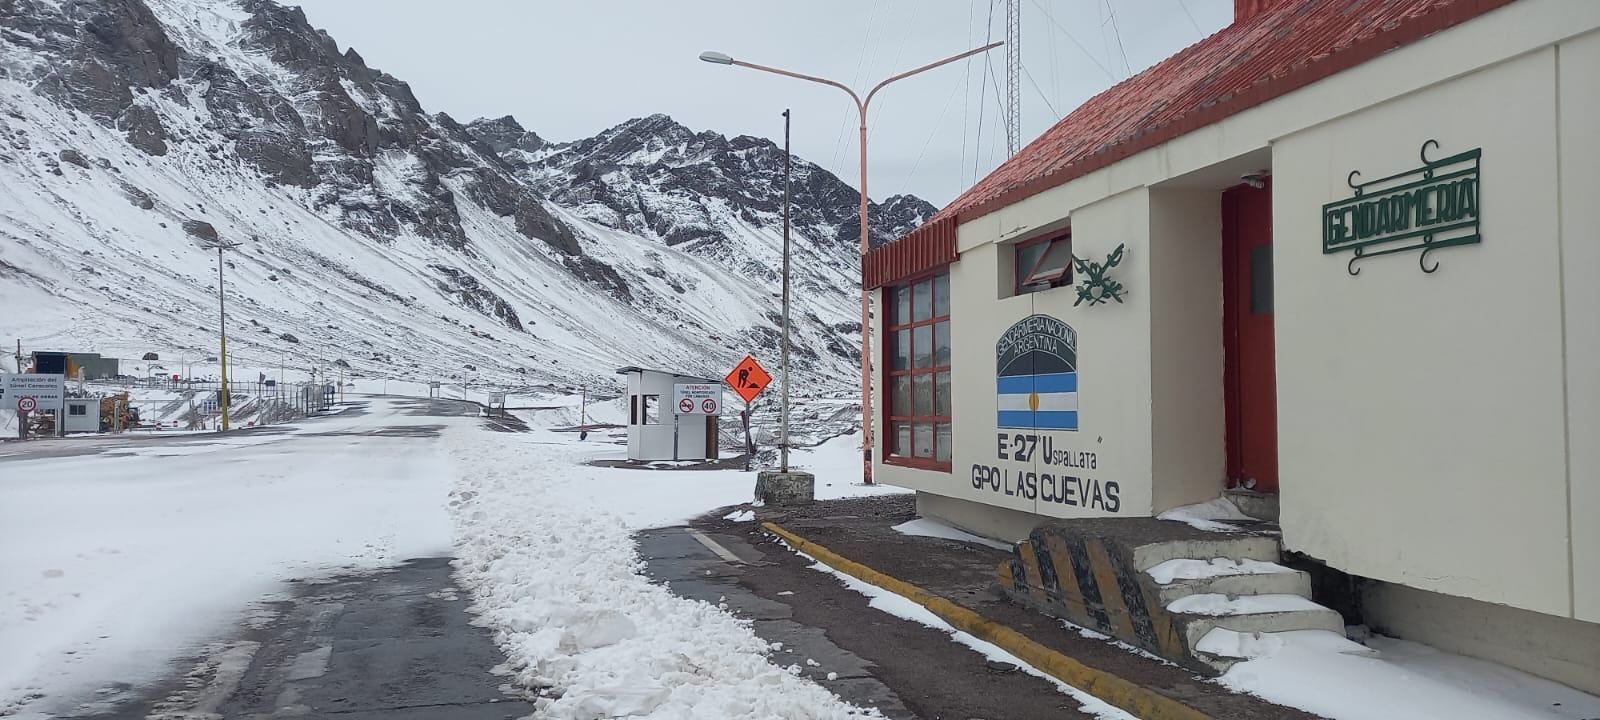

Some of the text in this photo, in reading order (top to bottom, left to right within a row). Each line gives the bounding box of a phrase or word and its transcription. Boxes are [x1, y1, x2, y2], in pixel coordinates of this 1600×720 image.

[1327, 178, 1475, 245] GENDARMERIA
[1014, 334, 1058, 357] ARGENTINA
[22, 400, 33, 408] 20
[704, 402, 714, 410] 40
[971, 464, 1121, 513] GPO LAS CUEVAS
